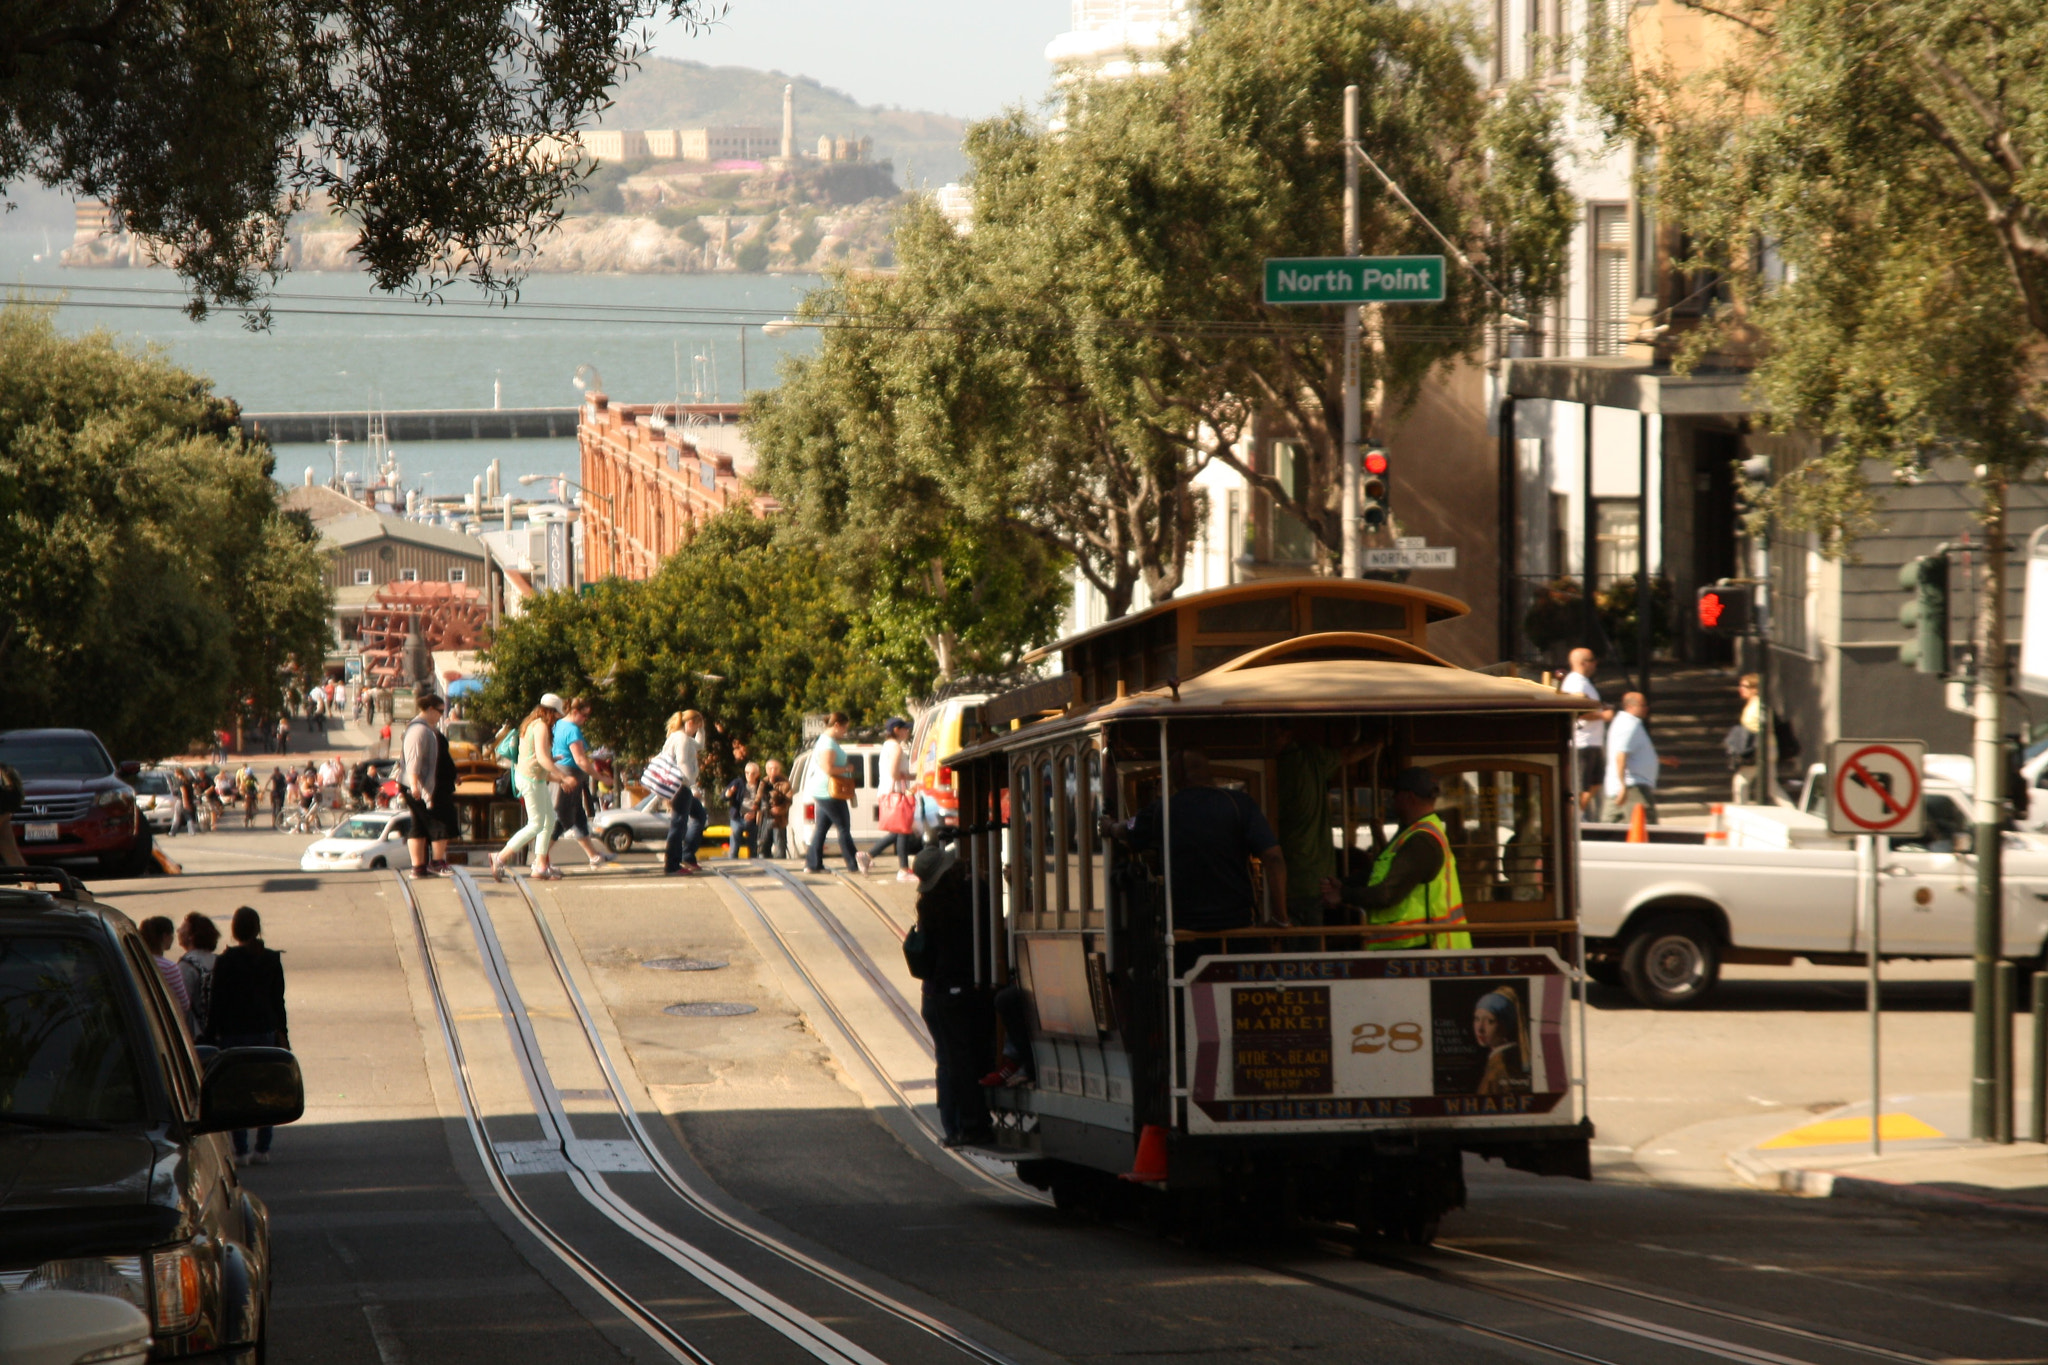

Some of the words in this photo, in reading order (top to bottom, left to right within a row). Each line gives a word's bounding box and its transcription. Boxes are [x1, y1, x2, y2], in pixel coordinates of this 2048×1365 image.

[1278, 270, 1353, 292] North
[1362, 268, 1430, 291] Point
[1371, 553, 1409, 564] NORTH
[1415, 552, 1447, 563] POINT
[1238, 961, 1355, 981] MARKET
[1385, 957, 1494, 977] STREET
[1237, 991, 1325, 1006] POWELL
[1260, 1005, 1304, 1016] AND
[1236, 1016, 1327, 1030] MARKET
[1352, 1022, 1423, 1054] 28
[1238, 1050, 1269, 1065] HYDE
[1288, 1049, 1328, 1064] BEACH
[1228, 1099, 1412, 1121] FISHERMANS
[1443, 1095, 1534, 1115] WHARF
